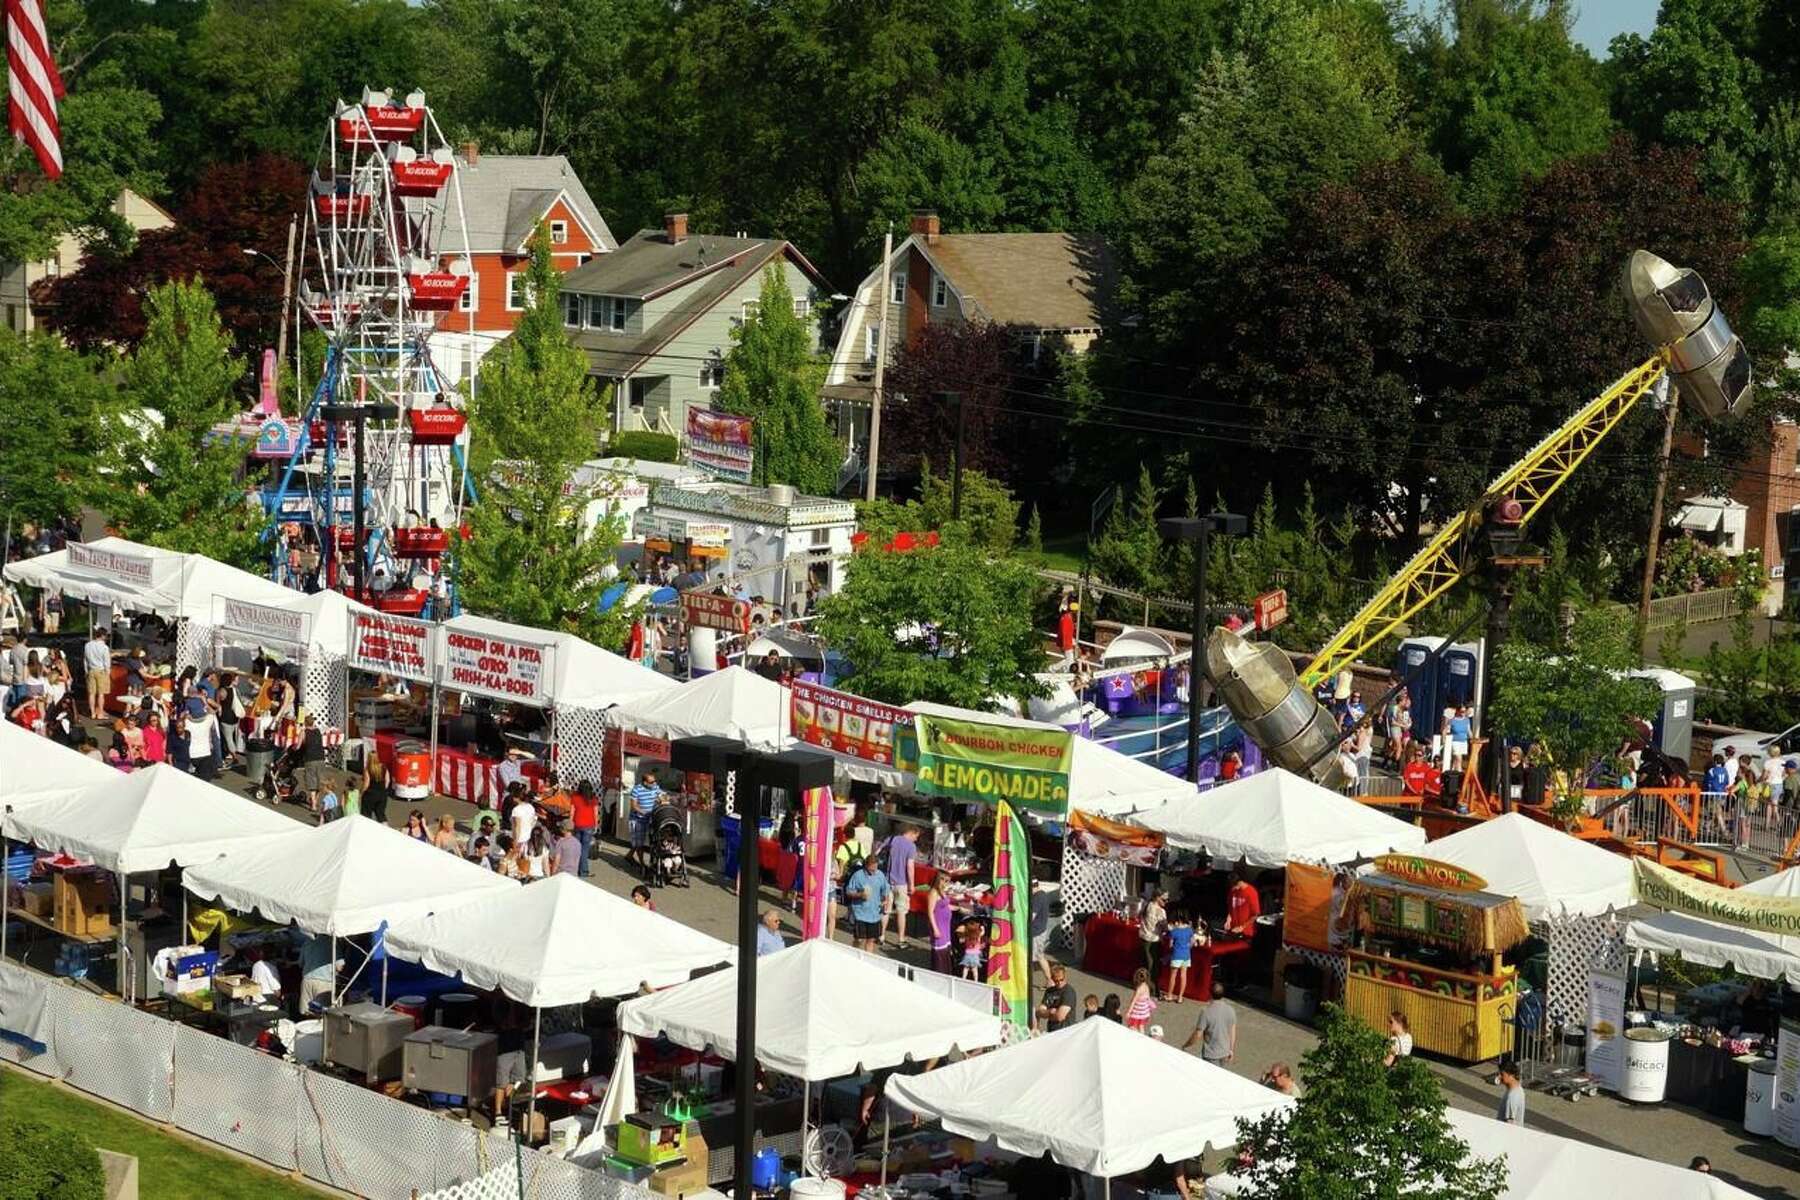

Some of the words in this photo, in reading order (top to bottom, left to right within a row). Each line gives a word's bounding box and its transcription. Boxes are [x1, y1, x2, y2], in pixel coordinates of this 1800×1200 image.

[414, 168, 439, 176] ROCKING
[448, 633, 487, 653] CHICKEN
[489, 642, 506, 656] ON
[507, 645, 517, 659] A
[519, 647, 542, 664] PITA
[478, 656, 509, 675] GYROS
[452, 667, 535, 697] SHISH-KA-BOBS
[794, 686, 810, 699] THE
[814, 692, 853, 710] CHICKEN
[855, 704, 893, 721] SMELLS
[626, 735, 663, 754] JAPANESE
[944, 733, 1006, 753] BOURBON
[1008, 742, 1064, 758] CHICKEN
[933, 761, 1052, 801] LEMONADE
[1386, 858, 1424, 876] MAUI
[1638, 876, 1674, 905] Fresh
[1677, 886, 1710, 914] Hand
[1711, 900, 1752, 924] Made
